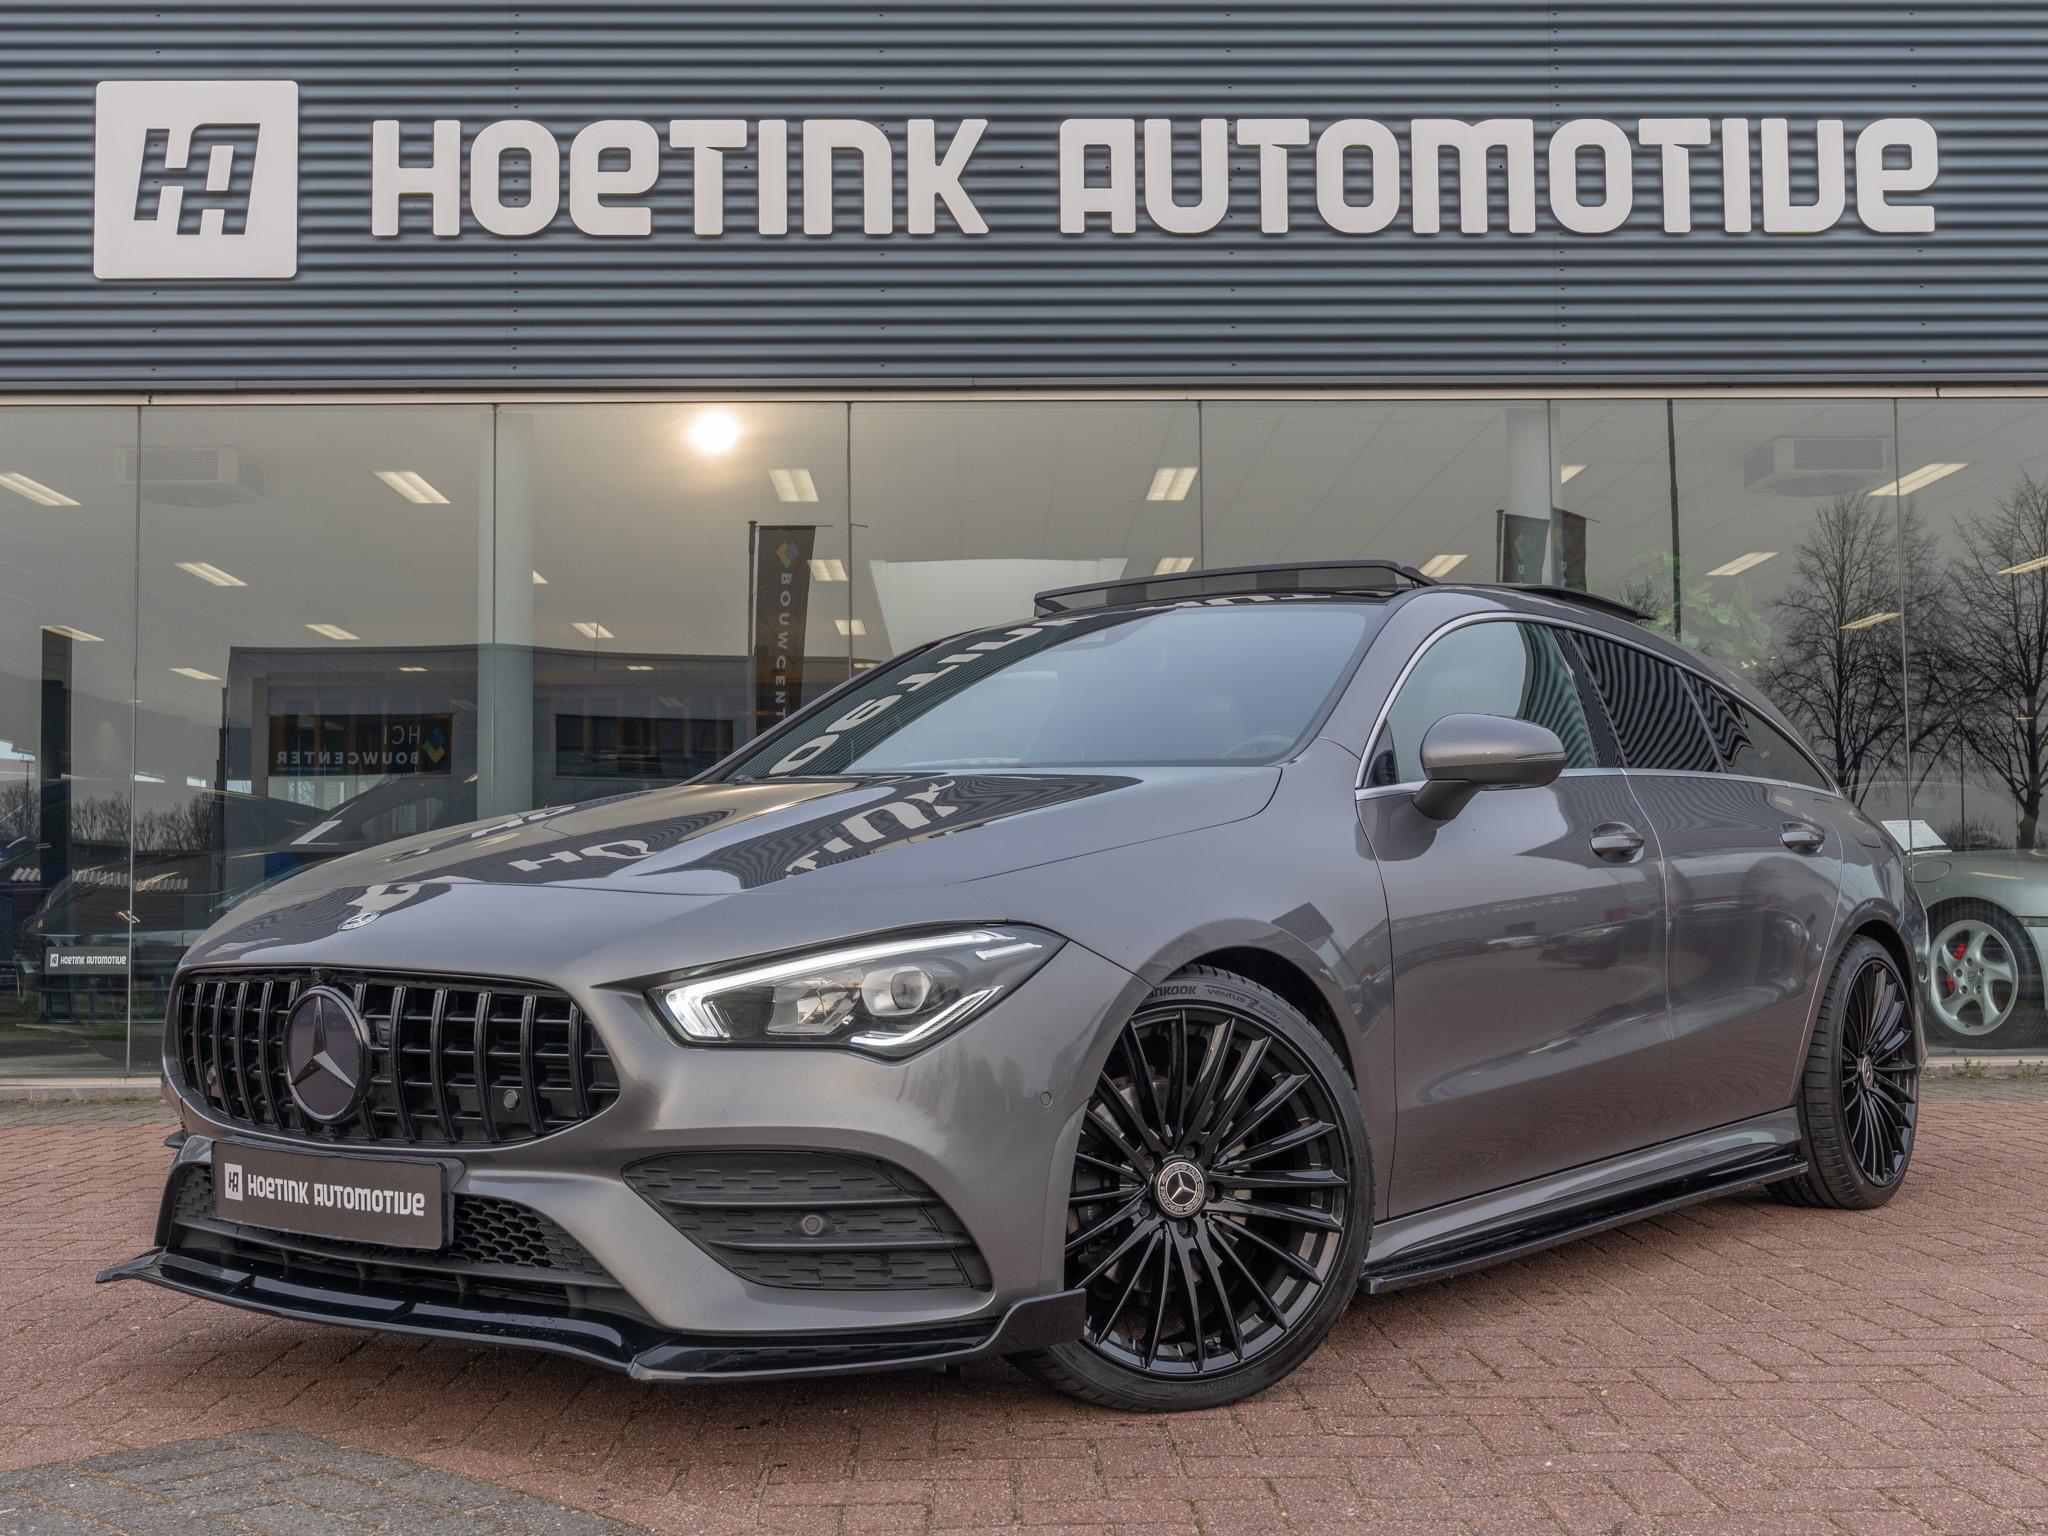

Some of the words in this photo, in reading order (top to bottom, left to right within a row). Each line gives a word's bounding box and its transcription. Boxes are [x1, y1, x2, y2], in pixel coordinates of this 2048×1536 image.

[371, 119, 989, 237] HOETINK
[1060, 117, 1939, 235] AUTOMOTIVE
[247, 1173, 309, 1205] HOETINK
[313, 1183, 425, 1217] AUTOMOTIVE
